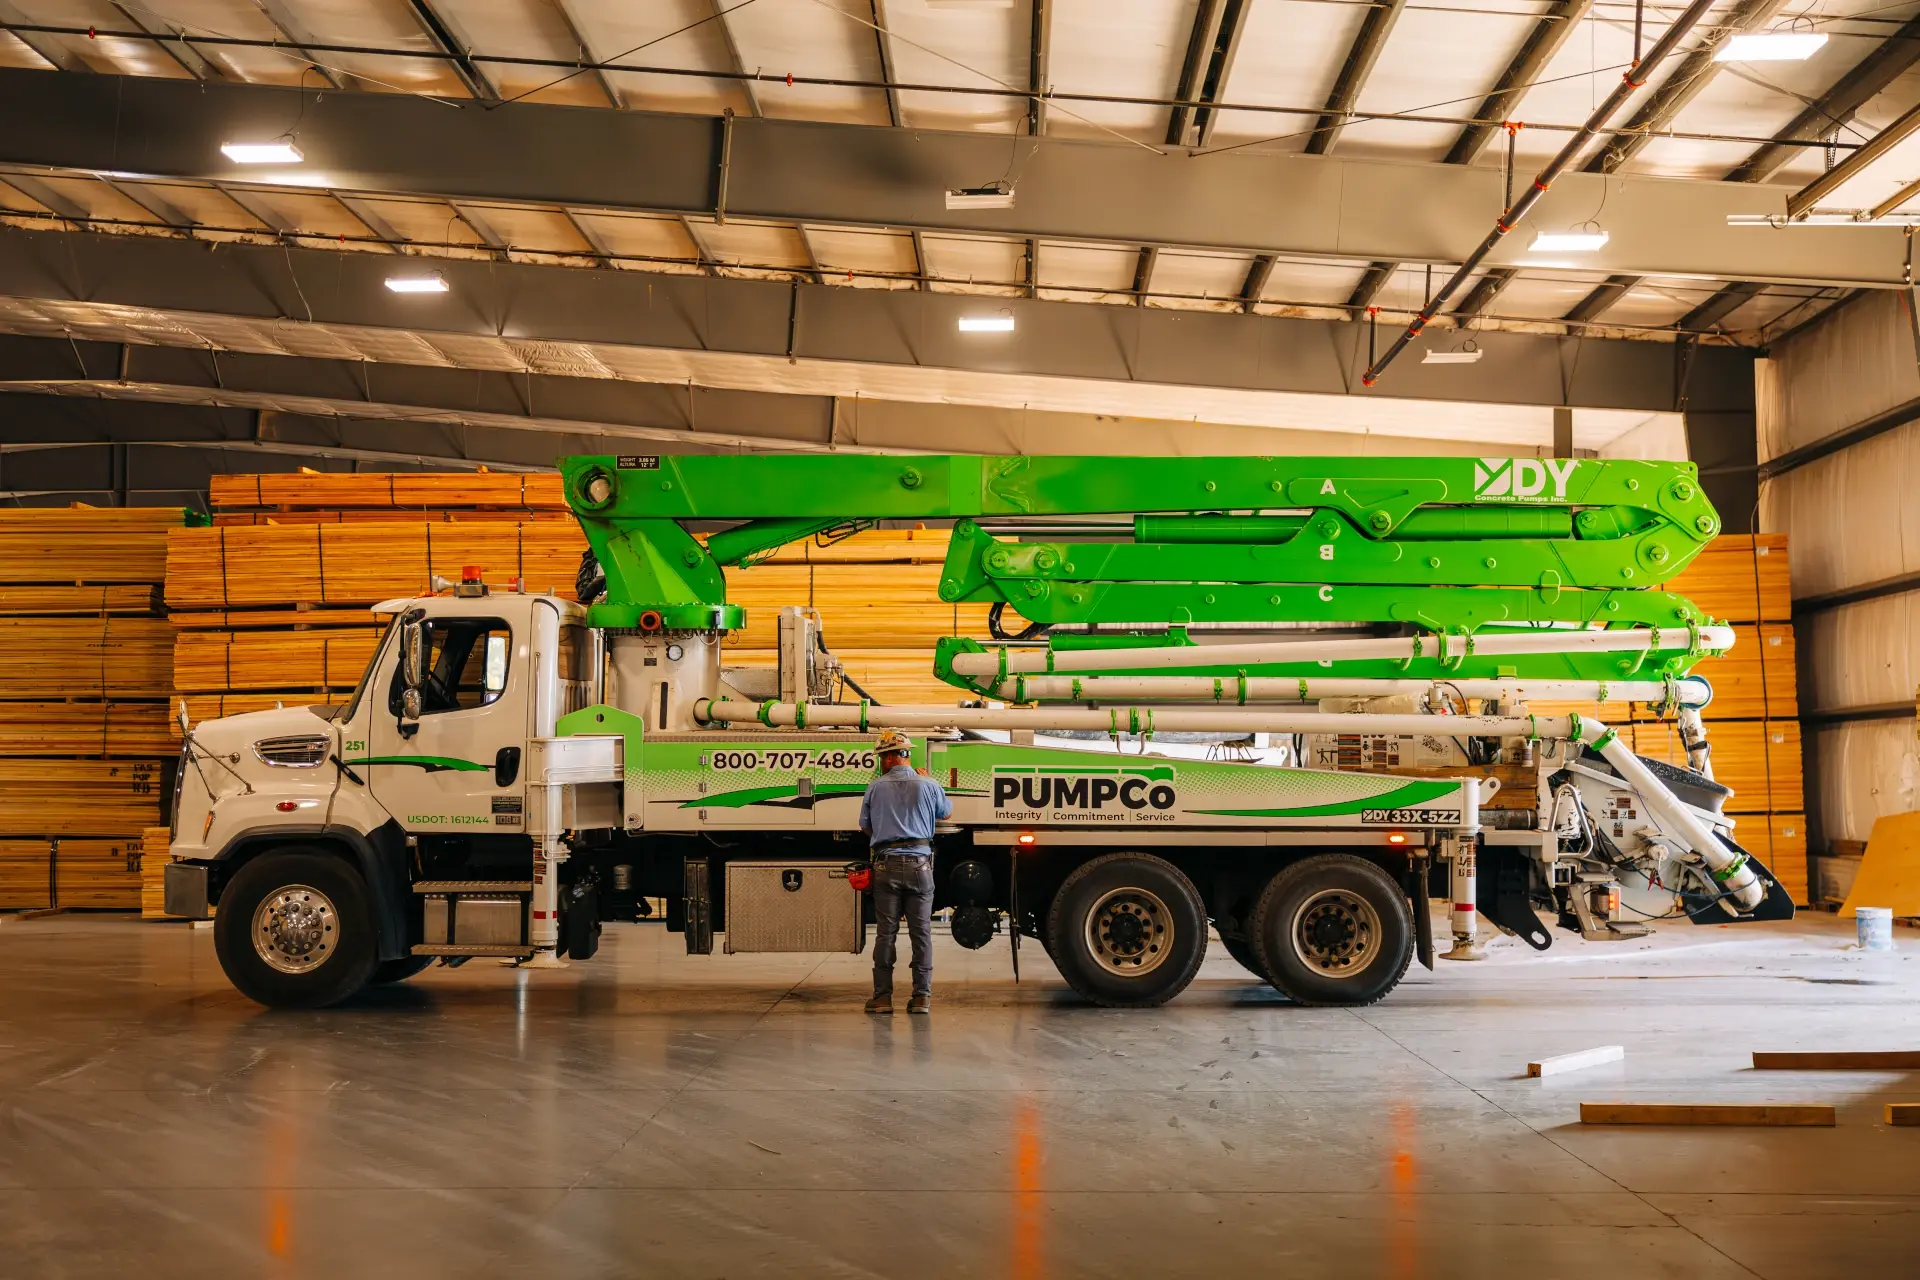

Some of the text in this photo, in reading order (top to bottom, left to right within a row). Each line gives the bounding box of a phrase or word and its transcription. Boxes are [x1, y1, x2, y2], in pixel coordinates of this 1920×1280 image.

[1320, 478, 1337, 495] A
[1517, 495, 1549, 503] Pumps
[1550, 495, 1568, 503] Inc.
[1319, 544, 1334, 561] B
[1318, 585, 1334, 602] C
[345, 740, 365, 751] 251
[713, 752, 875, 770] 800-707-4846
[993, 777, 1176, 809] PUMPCo
[407, 815, 489, 824] USDOT: 1612144
[995, 810, 1176, 822] Integrity Commitment Service
[1391, 810, 1460, 823] 33X-5ZZ
